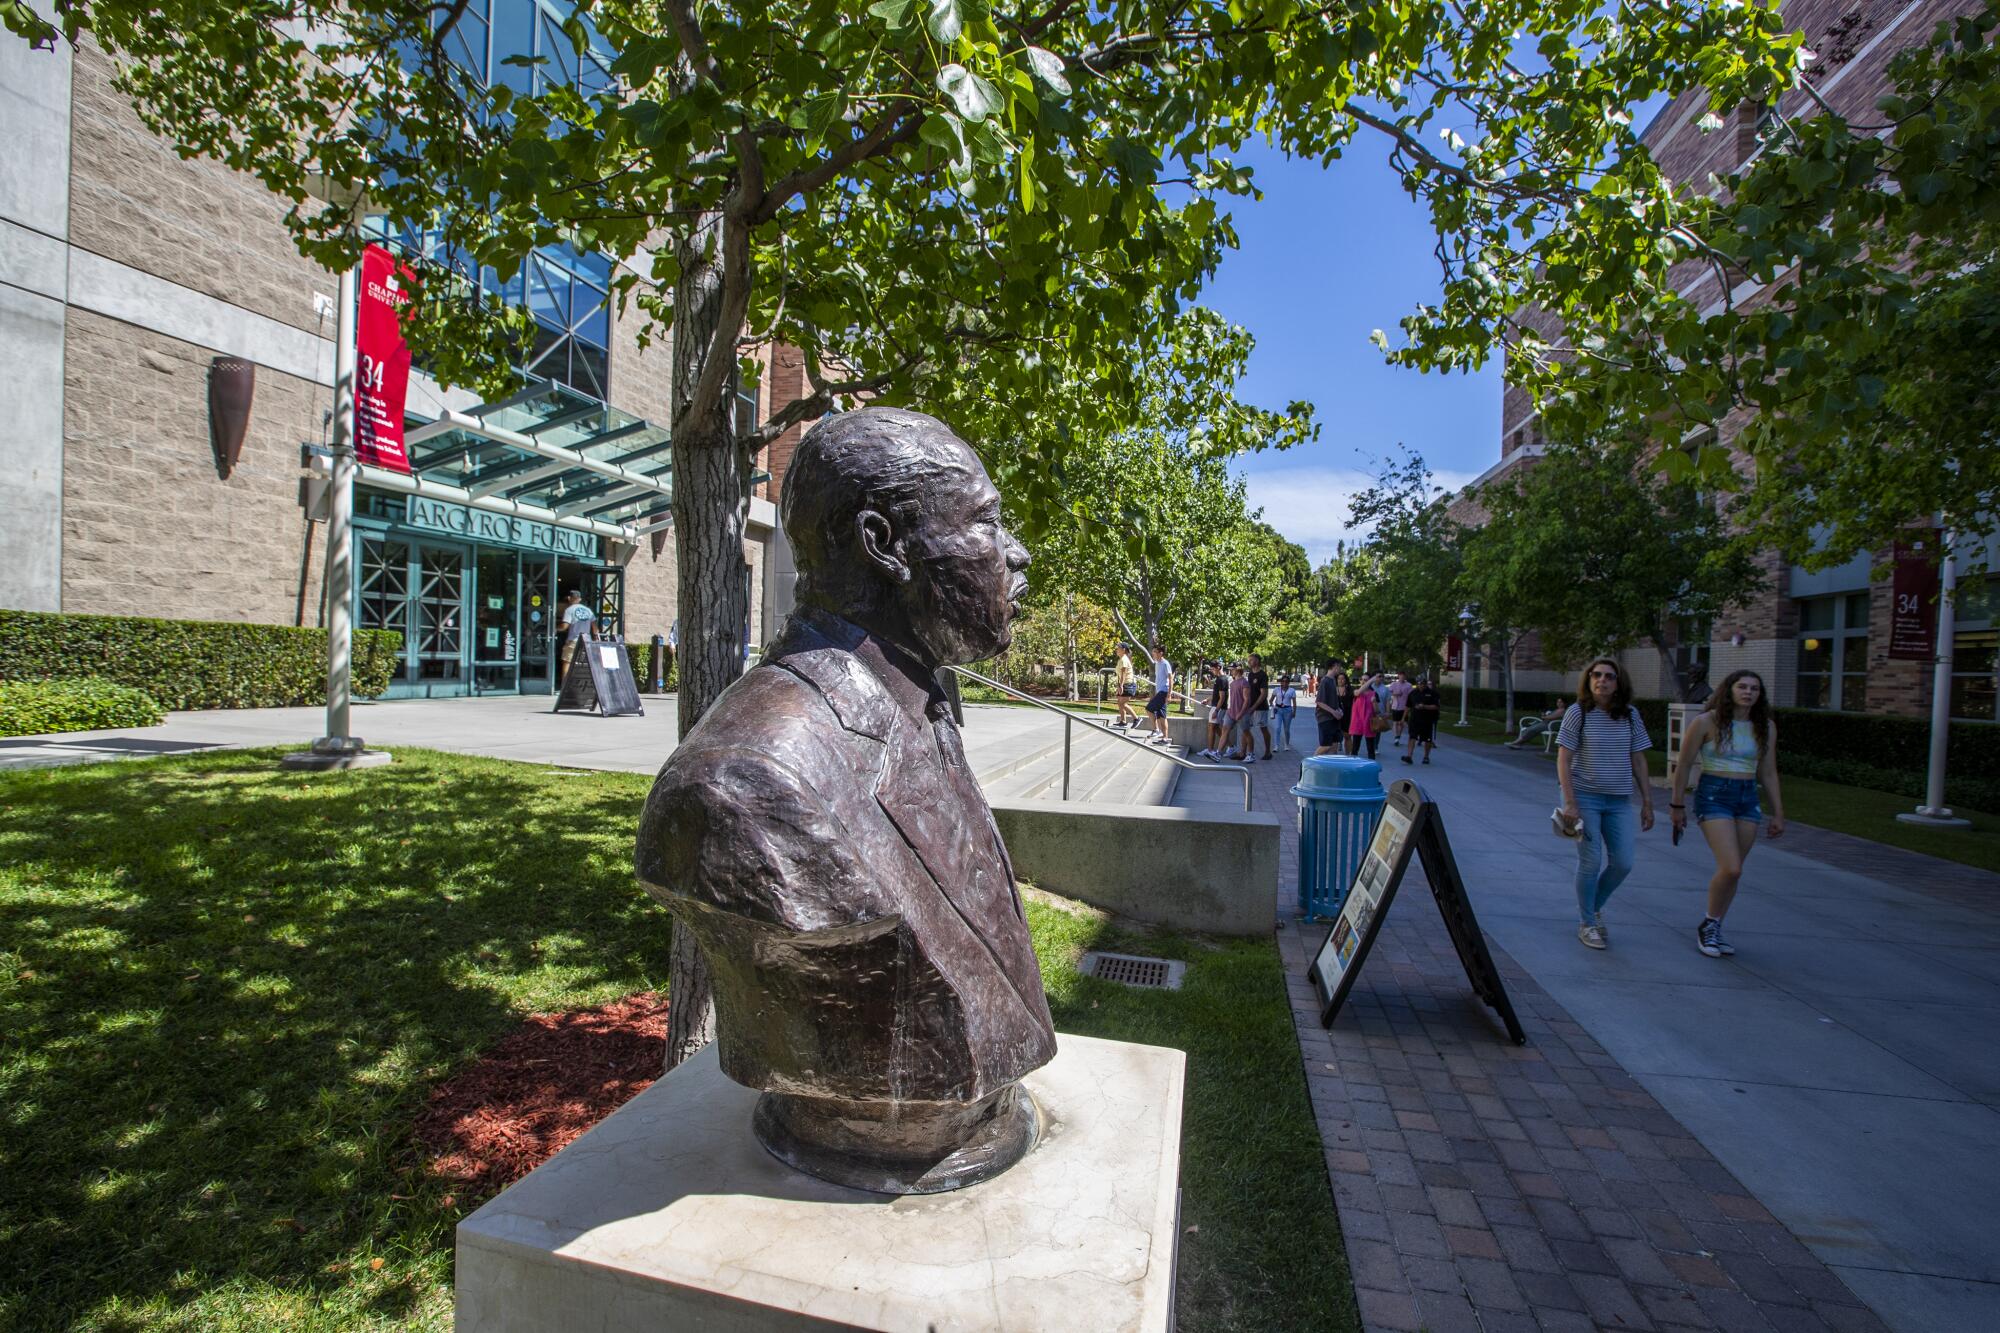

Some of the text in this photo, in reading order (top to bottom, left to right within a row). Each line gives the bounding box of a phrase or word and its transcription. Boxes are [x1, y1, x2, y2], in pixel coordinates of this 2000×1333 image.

[368, 289, 394, 307] UNIVE
[362, 354, 384, 393] 34
[412, 501, 595, 555] ARGYROS FORUM
[1898, 593, 1919, 614] 34
